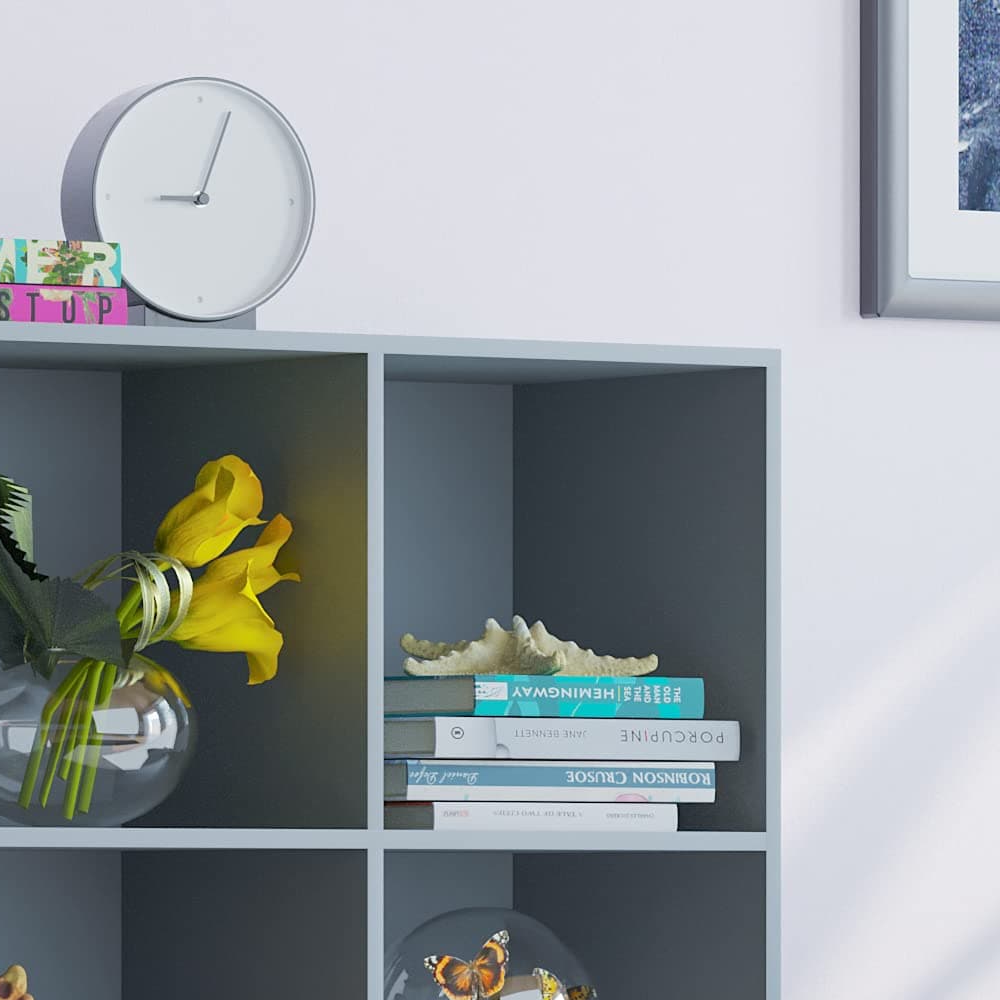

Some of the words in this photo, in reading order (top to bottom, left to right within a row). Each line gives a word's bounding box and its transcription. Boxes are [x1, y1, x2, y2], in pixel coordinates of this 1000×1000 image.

[512, 686, 615, 700] HEMINGWAY
[624, 686, 632, 703] SEA
[633, 686, 642, 703] THE
[643, 686, 652, 703] AND
[653, 686, 662, 703] MAN
[663, 686, 672, 703] OLD
[673, 686, 682, 703] THE
[513, 728, 559, 738] BENNETT
[562, 729, 588, 739] JANE
[619, 729, 725, 745] PORCUPINE
[440, 771, 479, 785] Daniel
[565, 770, 628, 785] CRUSOE
[632, 771, 711, 786] ROBINSON
[521, 809, 540, 817] TWO
